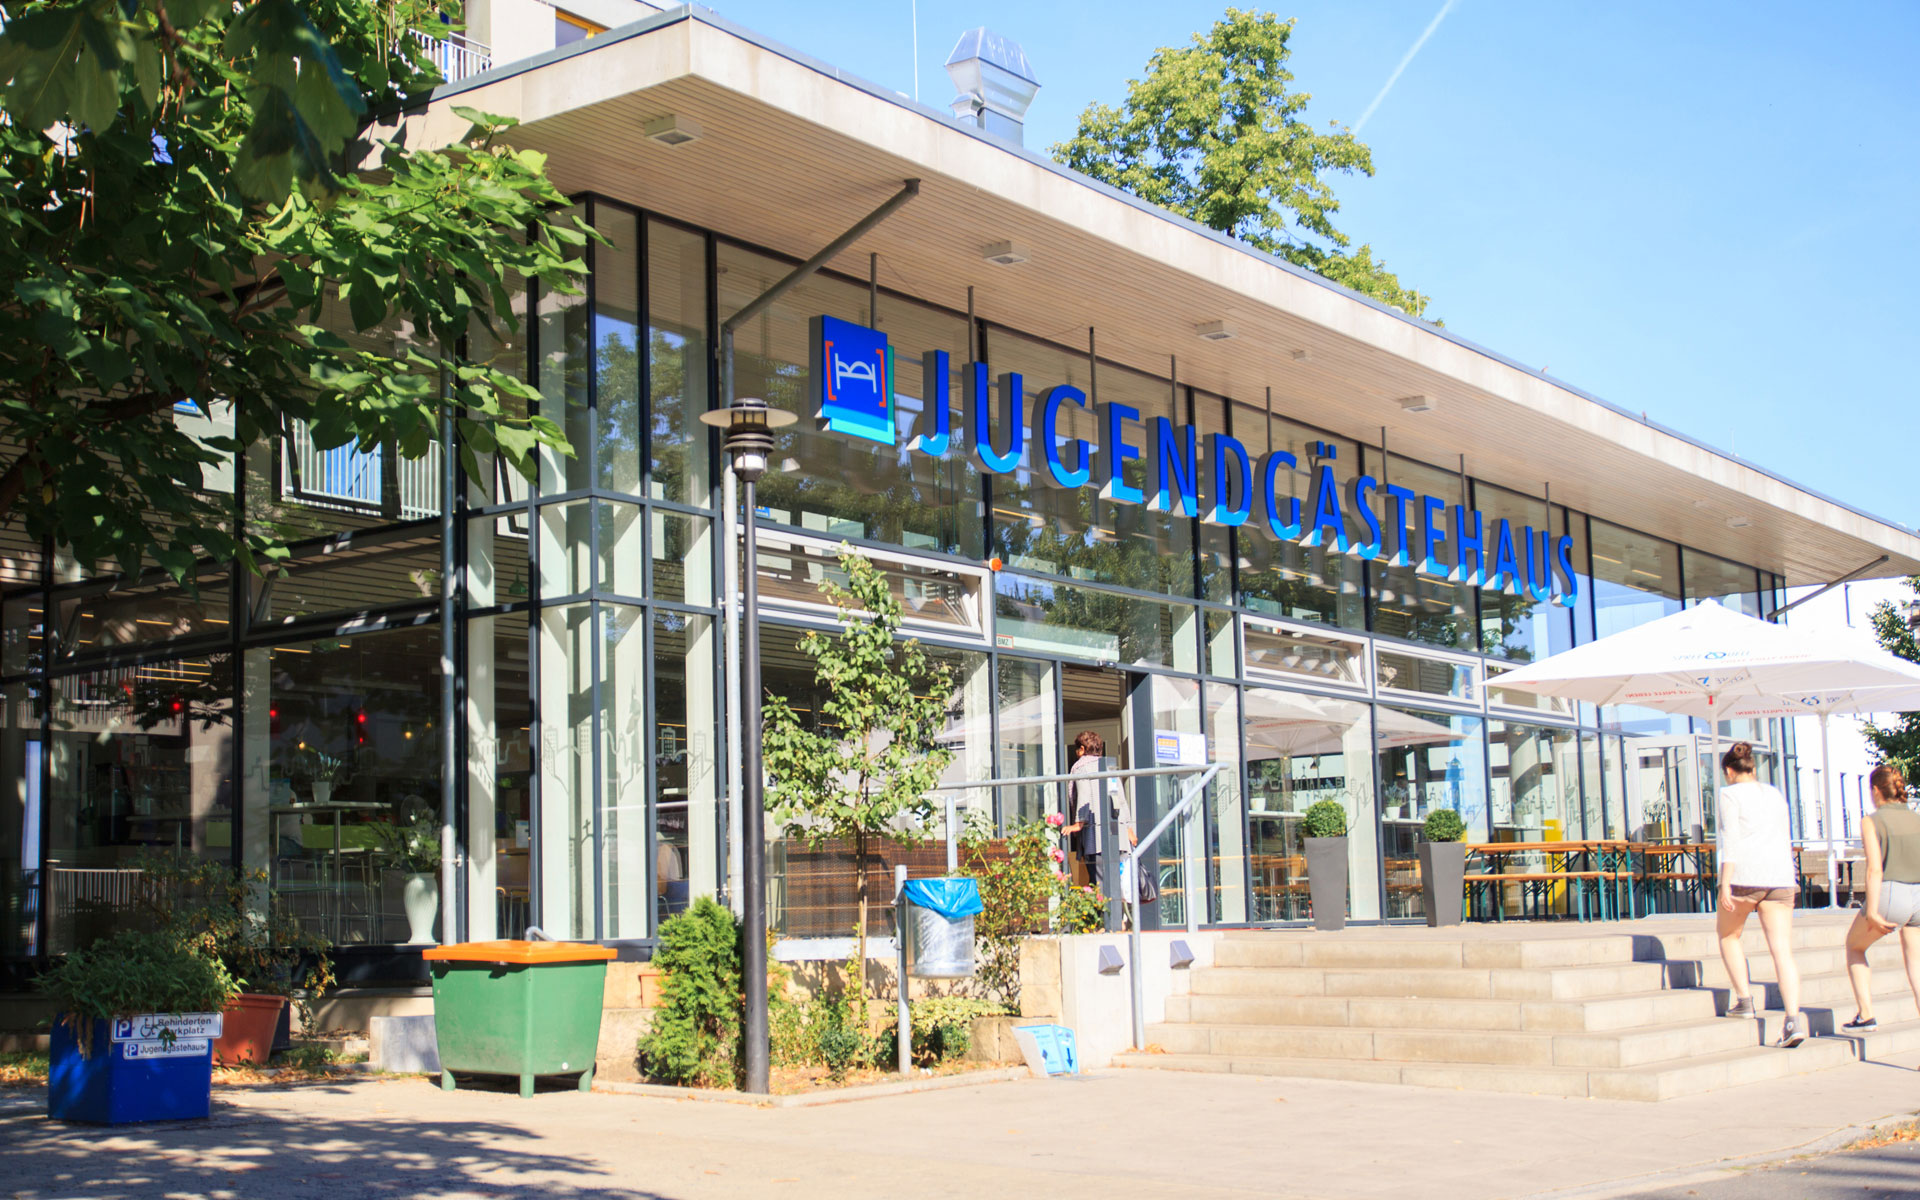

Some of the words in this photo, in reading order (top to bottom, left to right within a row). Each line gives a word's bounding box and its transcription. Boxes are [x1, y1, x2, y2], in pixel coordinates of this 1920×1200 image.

[908, 349, 1578, 607] JUGENDGÄSTEHAUS
[158, 1017, 212, 1026] Behinderten
[129, 1044, 137, 1056] P
[140, 1043, 204, 1054] Jugengästehaus
